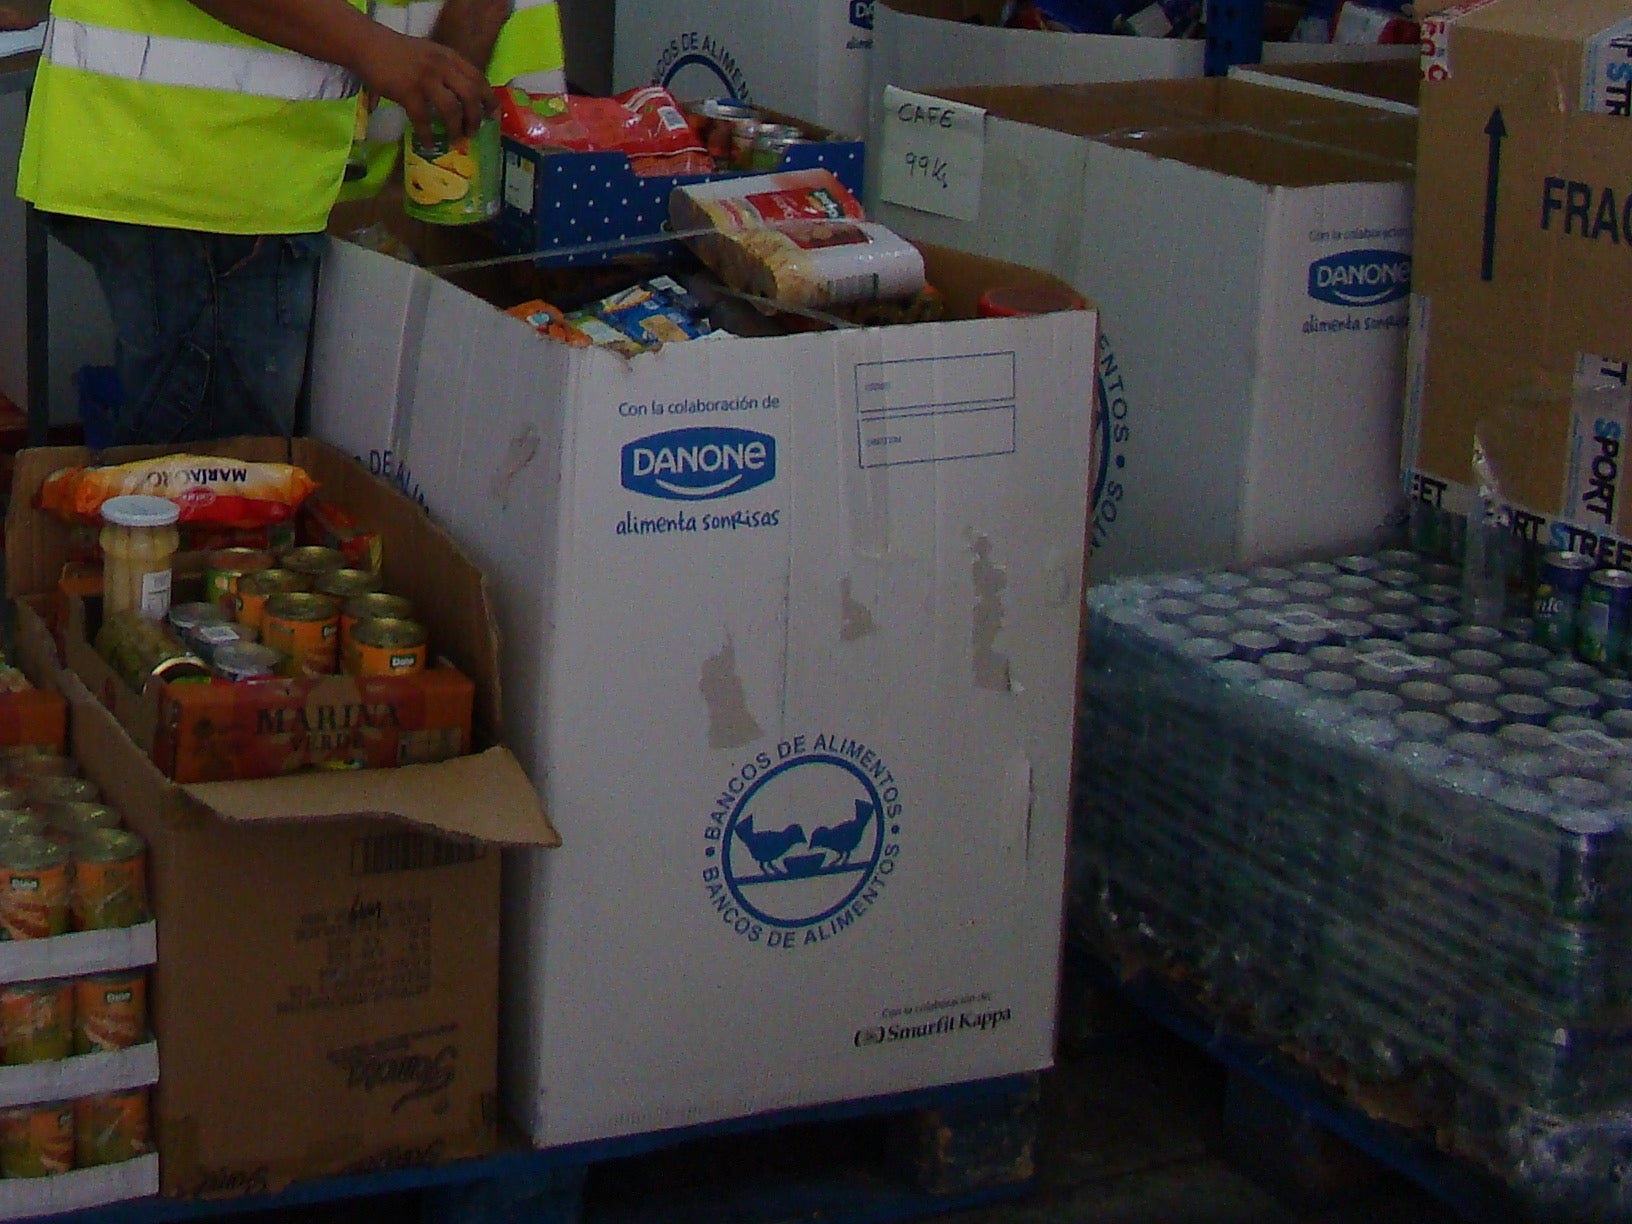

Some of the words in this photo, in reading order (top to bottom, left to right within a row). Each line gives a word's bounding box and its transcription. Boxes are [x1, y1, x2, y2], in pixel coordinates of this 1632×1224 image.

[681, 32, 699, 51] DE
[618, 402, 647, 417] Con
[651, 401, 664, 416] la
[668, 395, 759, 415] colaboración
[763, 395, 780, 410] de
[369, 449, 393, 477] DE
[632, 440, 768, 477] DANONE
[1581, 417, 1621, 524] SPORT
[616, 510, 698, 536] alimenta
[704, 752, 772, 840] BANCOS
[777, 735, 807, 759] DE
[813, 733, 903, 819] ALIMENTOS
[703, 866, 763, 942] BANCOS
[767, 931, 796, 949] DE
[803, 843, 901, 946] ALIMENTOS
[959, 1007, 1012, 1031] Kappa
